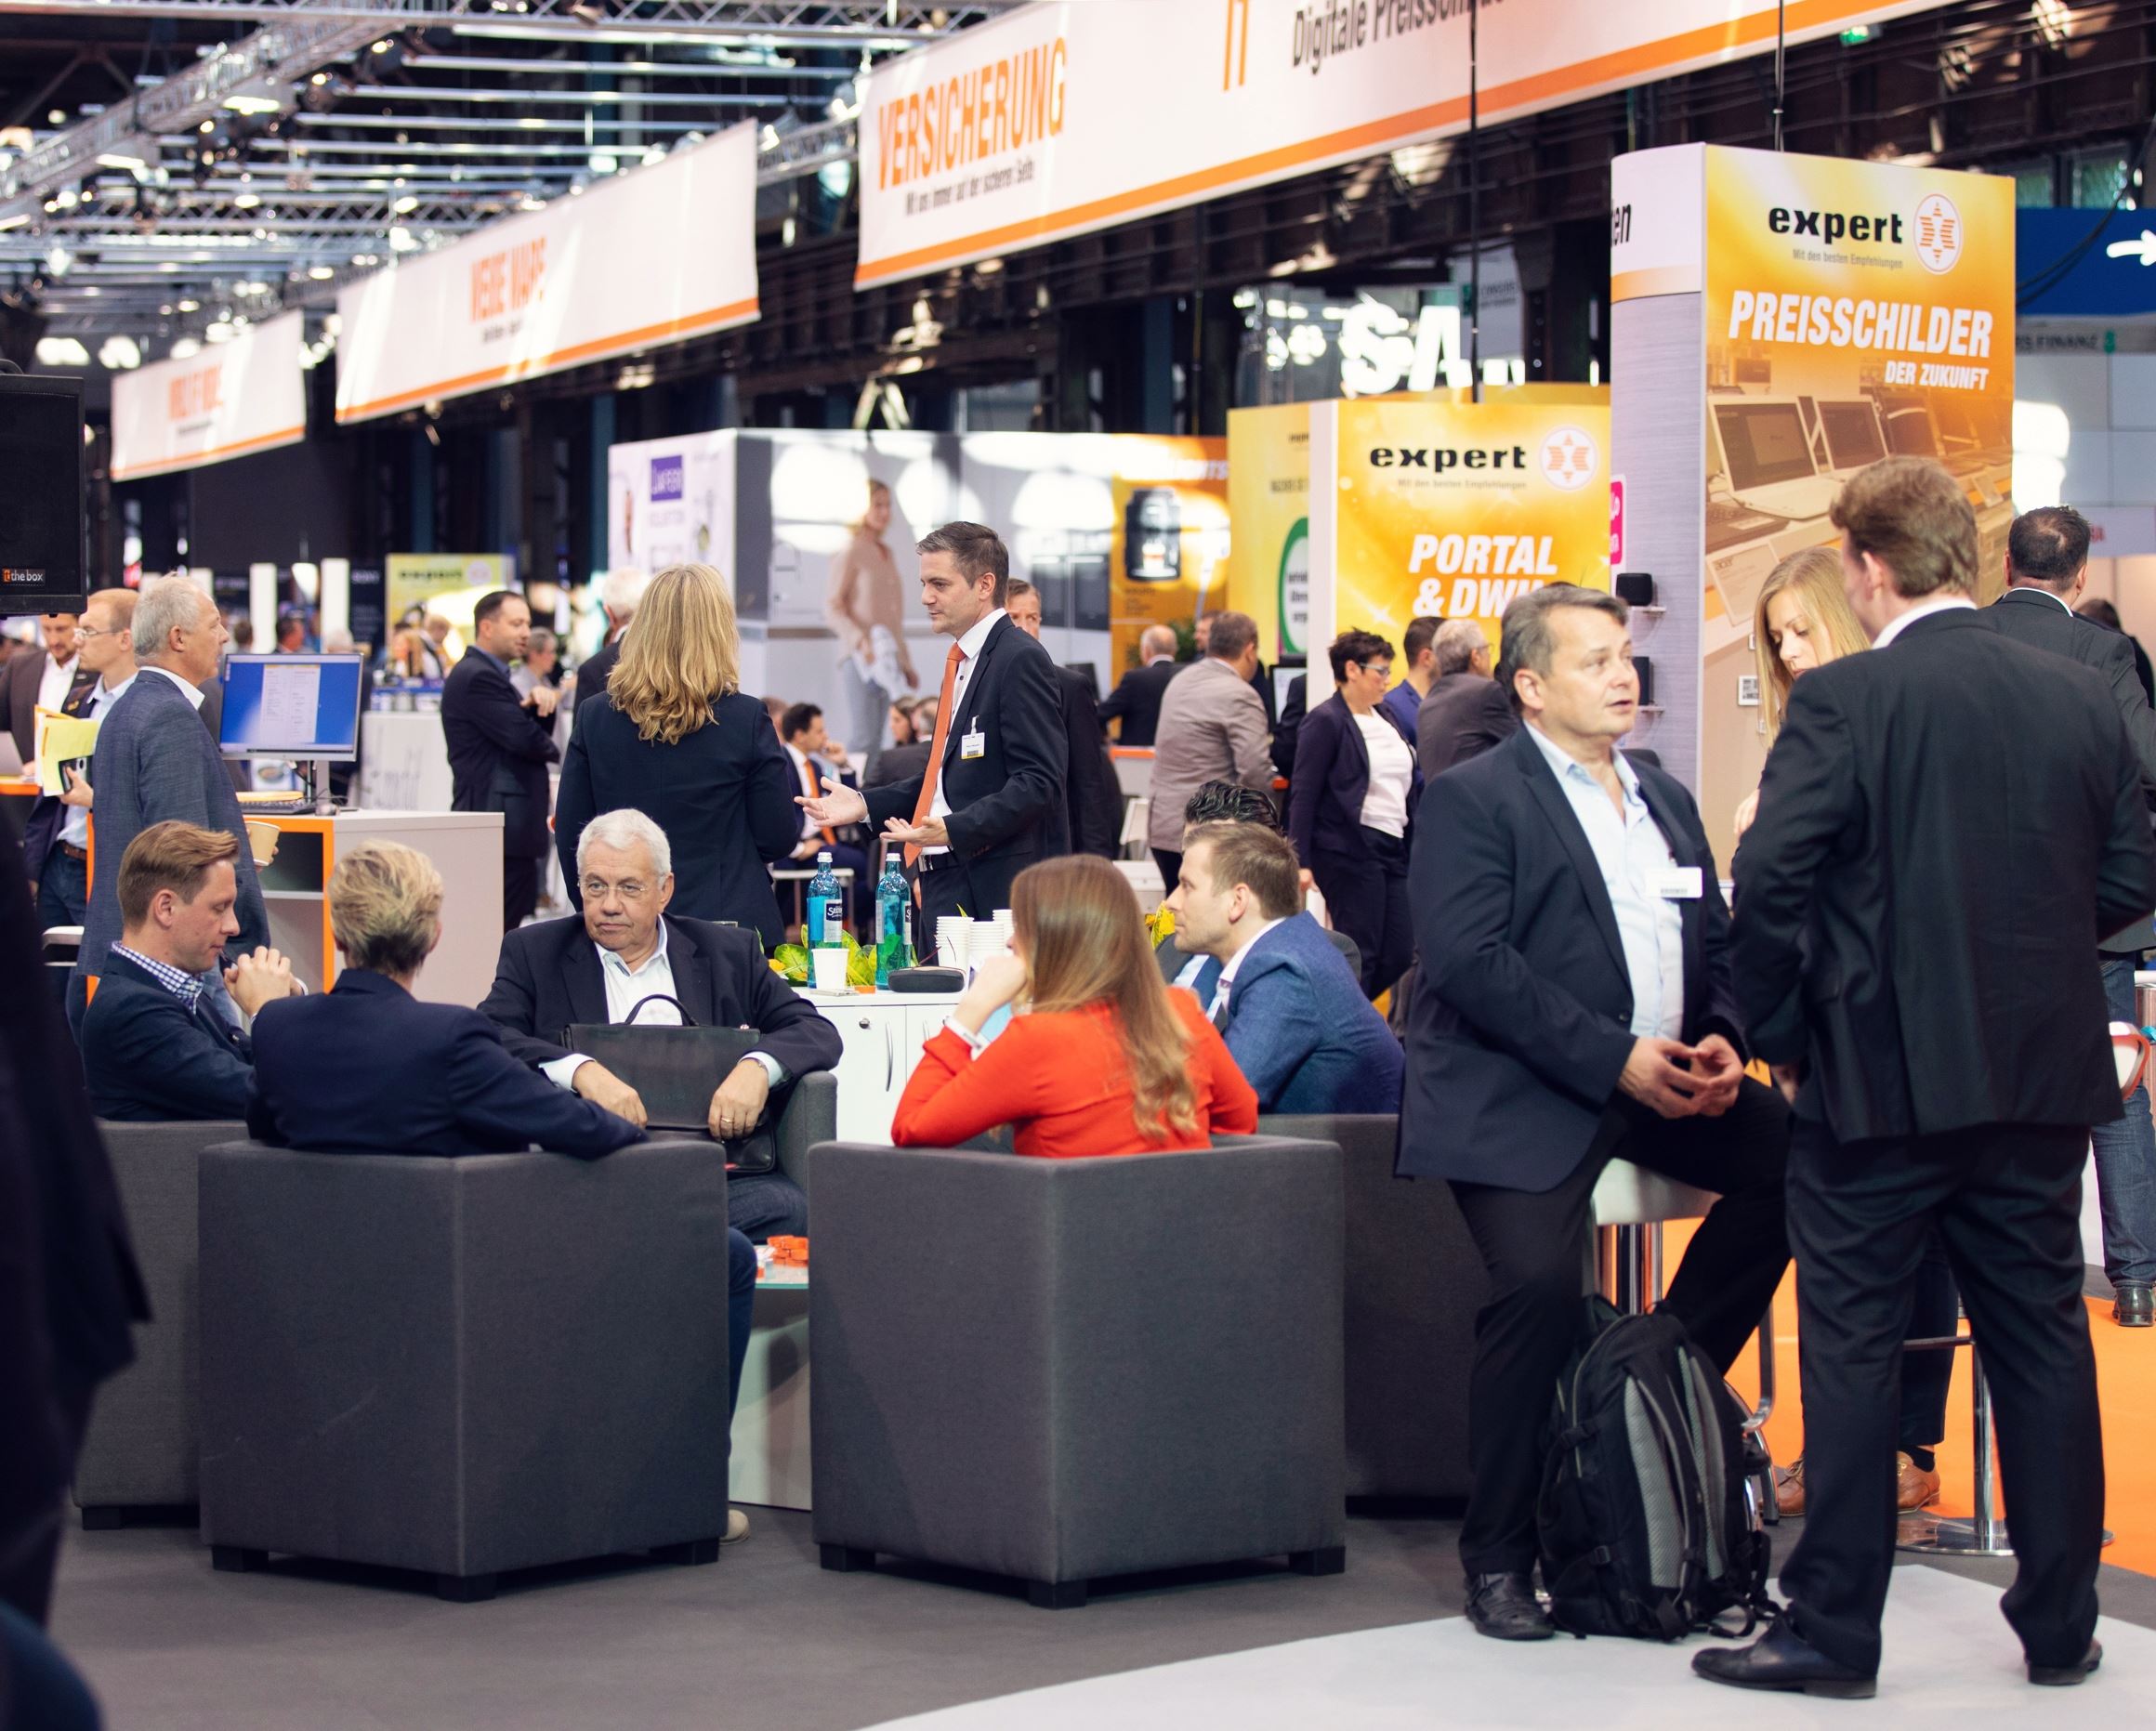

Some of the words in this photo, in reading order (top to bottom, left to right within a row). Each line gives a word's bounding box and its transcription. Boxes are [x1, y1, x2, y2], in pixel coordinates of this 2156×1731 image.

[1292, 0, 1367, 75] Digitale
[879, 37, 1066, 191] VERSICHERUNG
[1768, 207, 1902, 244] expert
[1729, 290, 1993, 358] PREISSCHILDER
[1885, 360, 1916, 387] DER
[1919, 361, 1990, 391] ZUKUNFT
[1370, 446, 1526, 473] expert
[1409, 533, 1558, 575] PORTAL
[1413, 577, 1445, 617] &
